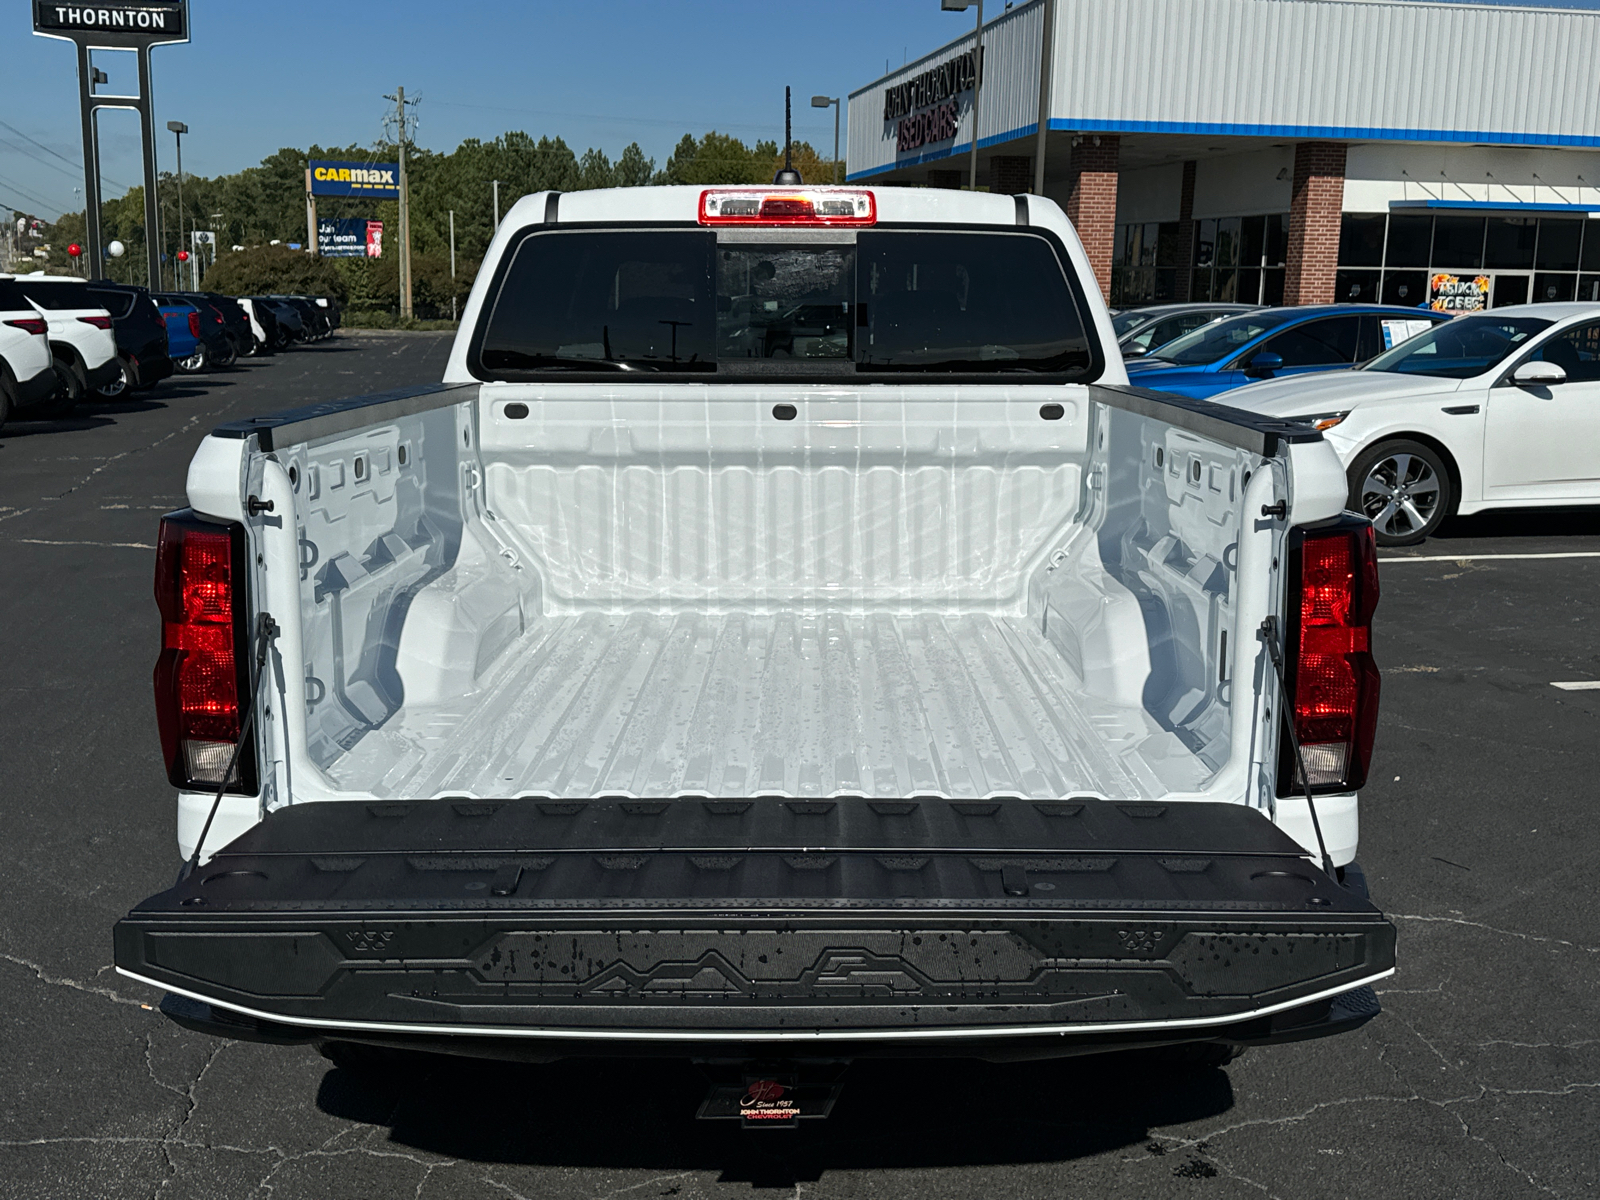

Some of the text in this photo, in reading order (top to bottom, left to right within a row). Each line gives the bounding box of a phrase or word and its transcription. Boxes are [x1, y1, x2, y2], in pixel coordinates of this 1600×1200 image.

[55, 7, 165, 28] THORNTON
[884, 46, 984, 121] JOHN THORNTON
[897, 100, 958, 152] USED CARS
[319, 224, 335, 233] Join
[318, 234, 357, 243] our team
[776, 1100, 793, 1108] 1957
